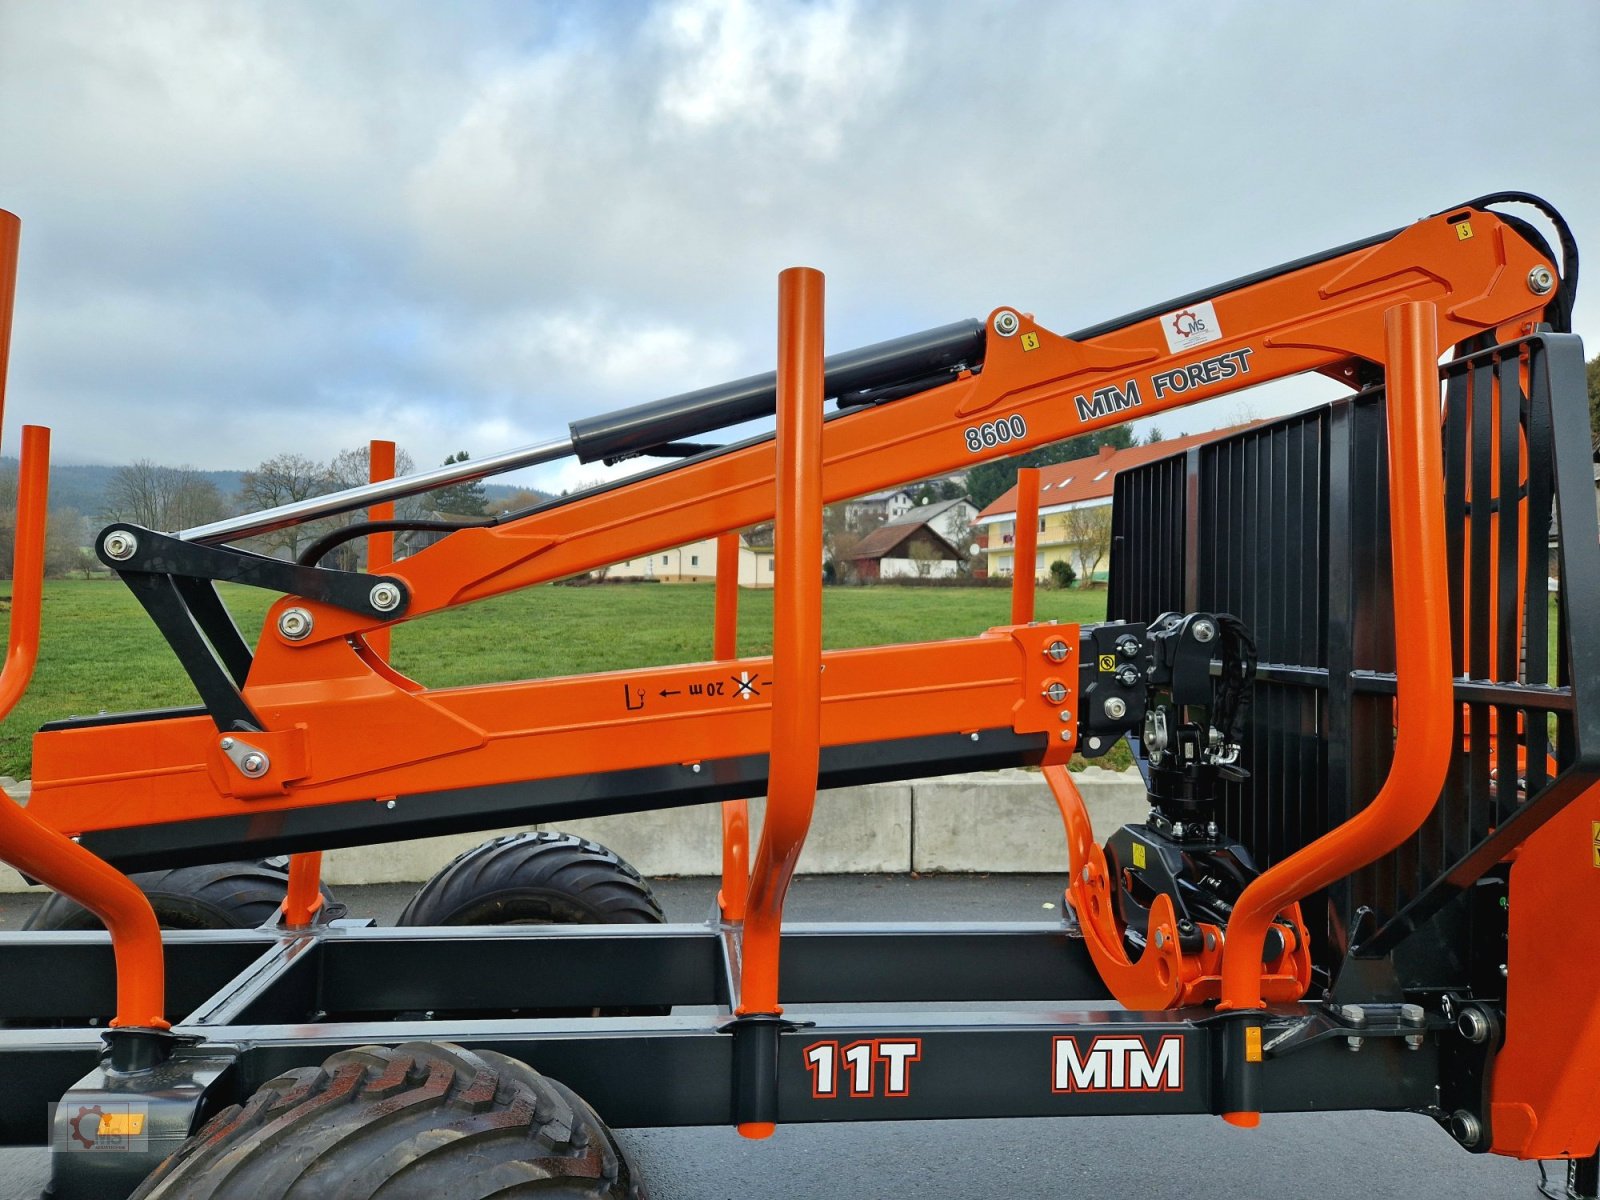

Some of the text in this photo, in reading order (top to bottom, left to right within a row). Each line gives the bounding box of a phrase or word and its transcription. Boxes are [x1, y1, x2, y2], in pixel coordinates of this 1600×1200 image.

[1188, 319, 1205, 333] MS
[1074, 347, 1253, 422] MTM FOREST
[965, 414, 1026, 451] 8600
[689, 682, 724, 697] 20 m
[803, 1038, 922, 1098] 11T
[1052, 1035, 1184, 1093] MTM
